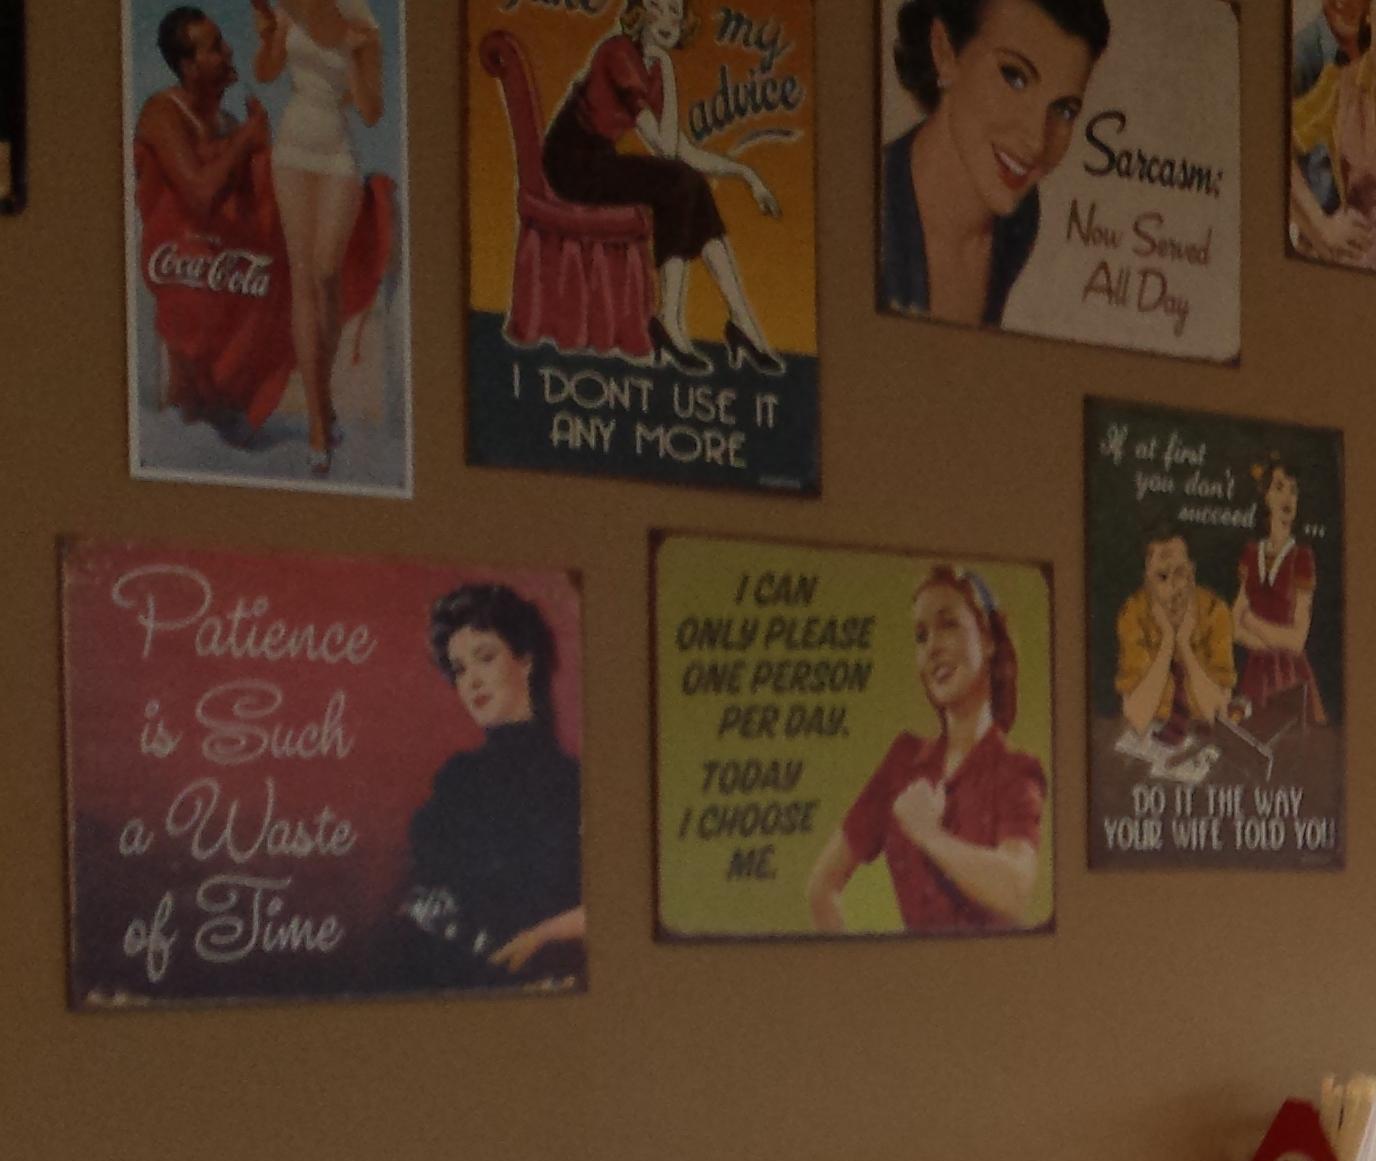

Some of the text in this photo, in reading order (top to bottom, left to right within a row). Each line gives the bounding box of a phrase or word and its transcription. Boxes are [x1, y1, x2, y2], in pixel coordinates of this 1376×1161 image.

[716, 7, 790, 74] my
[688, 64, 801, 141] advice
[1066, 197, 1213, 266] Now Served
[1081, 260, 1190, 338] All Day
[512, 361, 521, 400] I
[673, 381, 737, 425] USE
[755, 391, 780, 430] IT
[551, 410, 748, 470] ANY MORE
[1135, 437, 1159, 460] at
[1136, 470, 1175, 502] you
[111, 564, 378, 664] Patience
[735, 571, 820, 608] I CAN
[676, 614, 877, 652] ONLY PLEASE
[681, 659, 874, 696] ONE PERSON
[140, 678, 355, 766] is Such
[718, 703, 780, 738] PER
[703, 758, 804, 795] TODAY
[1132, 785, 1303, 818] DO IT THE WAY
[119, 776, 359, 864] a Waste
[679, 798, 821, 841] I CHOOSE
[1103, 816, 1336, 851] YOUR WIFE TOLD YOU
[123, 873, 347, 984] of Time
